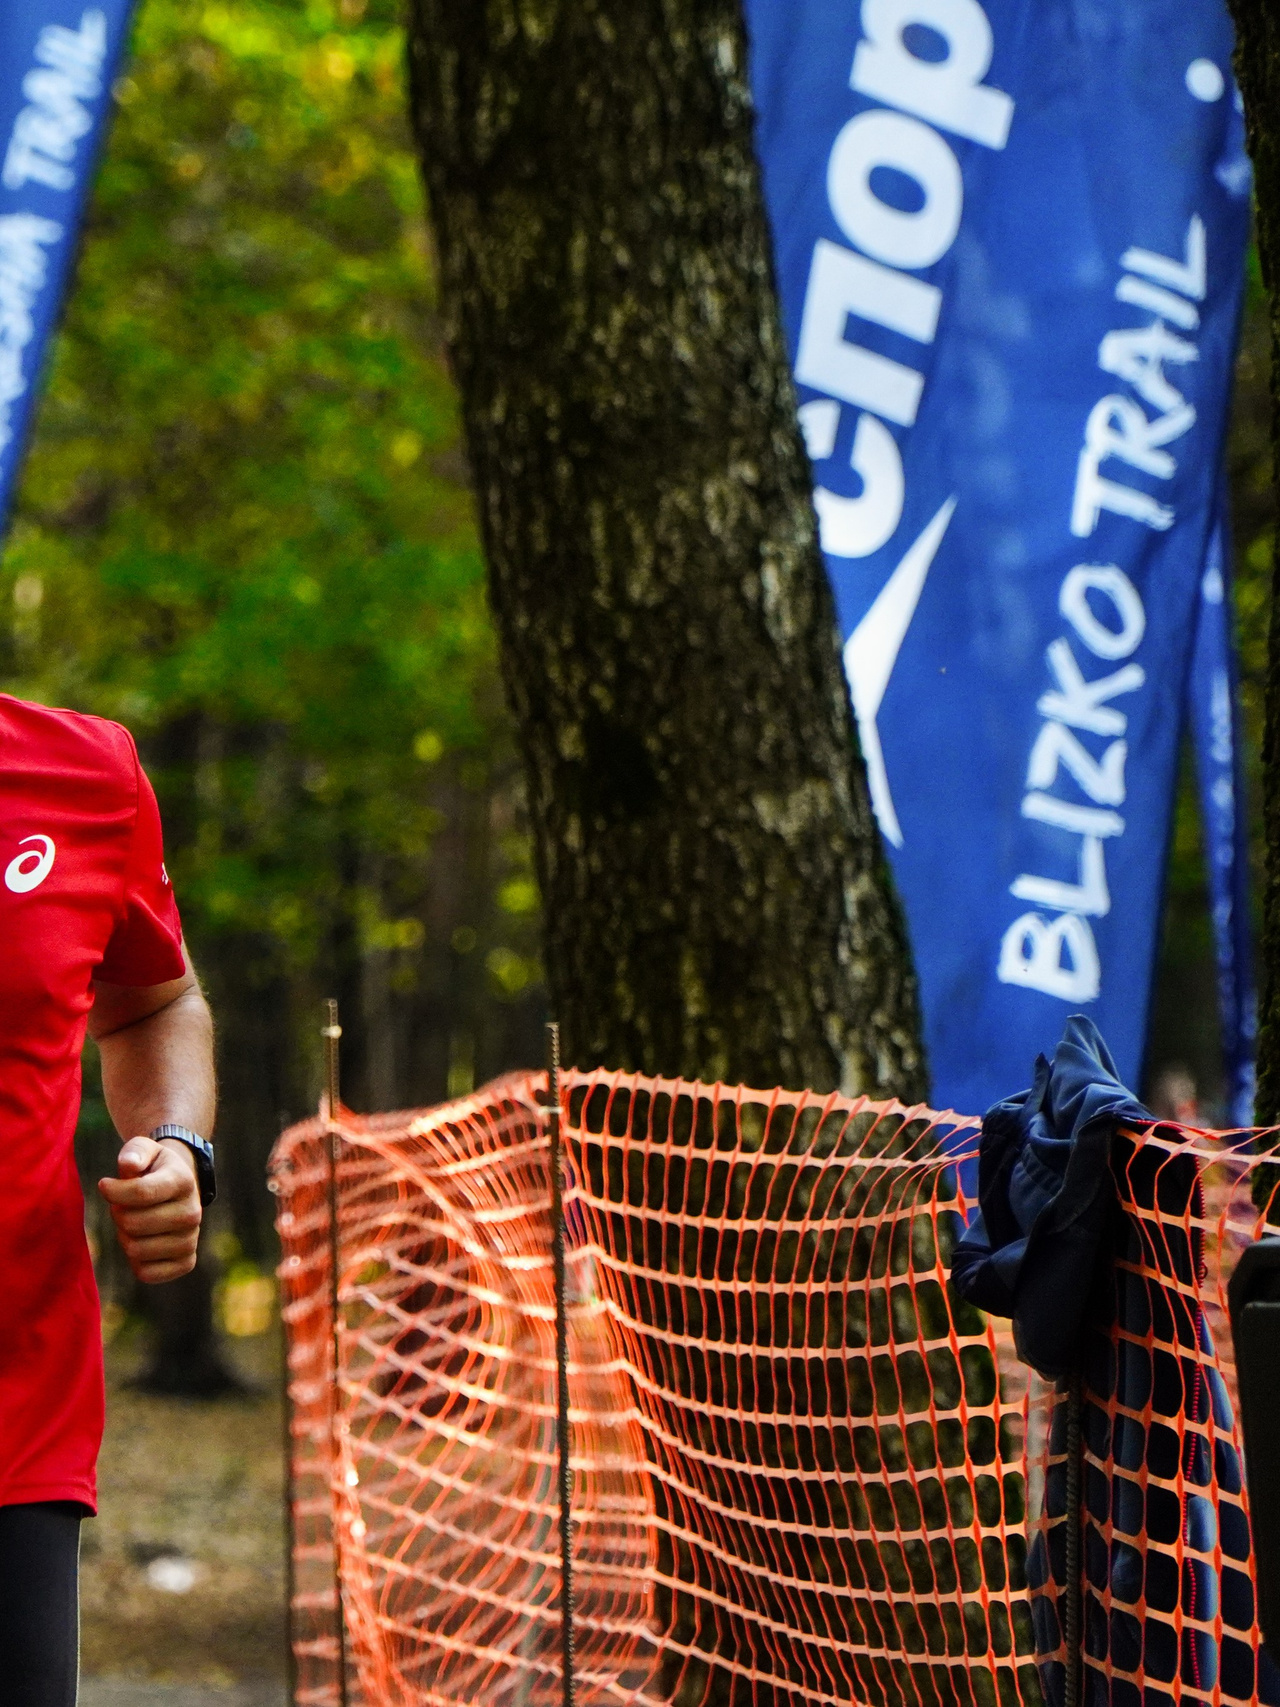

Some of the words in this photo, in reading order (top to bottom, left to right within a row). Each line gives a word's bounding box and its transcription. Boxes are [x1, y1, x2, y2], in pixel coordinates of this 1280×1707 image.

[1, 9, 108, 190] TRAIL
[1070, 212, 1208, 538] TRAIL
[997, 563, 1146, 1004] BLIZKO
